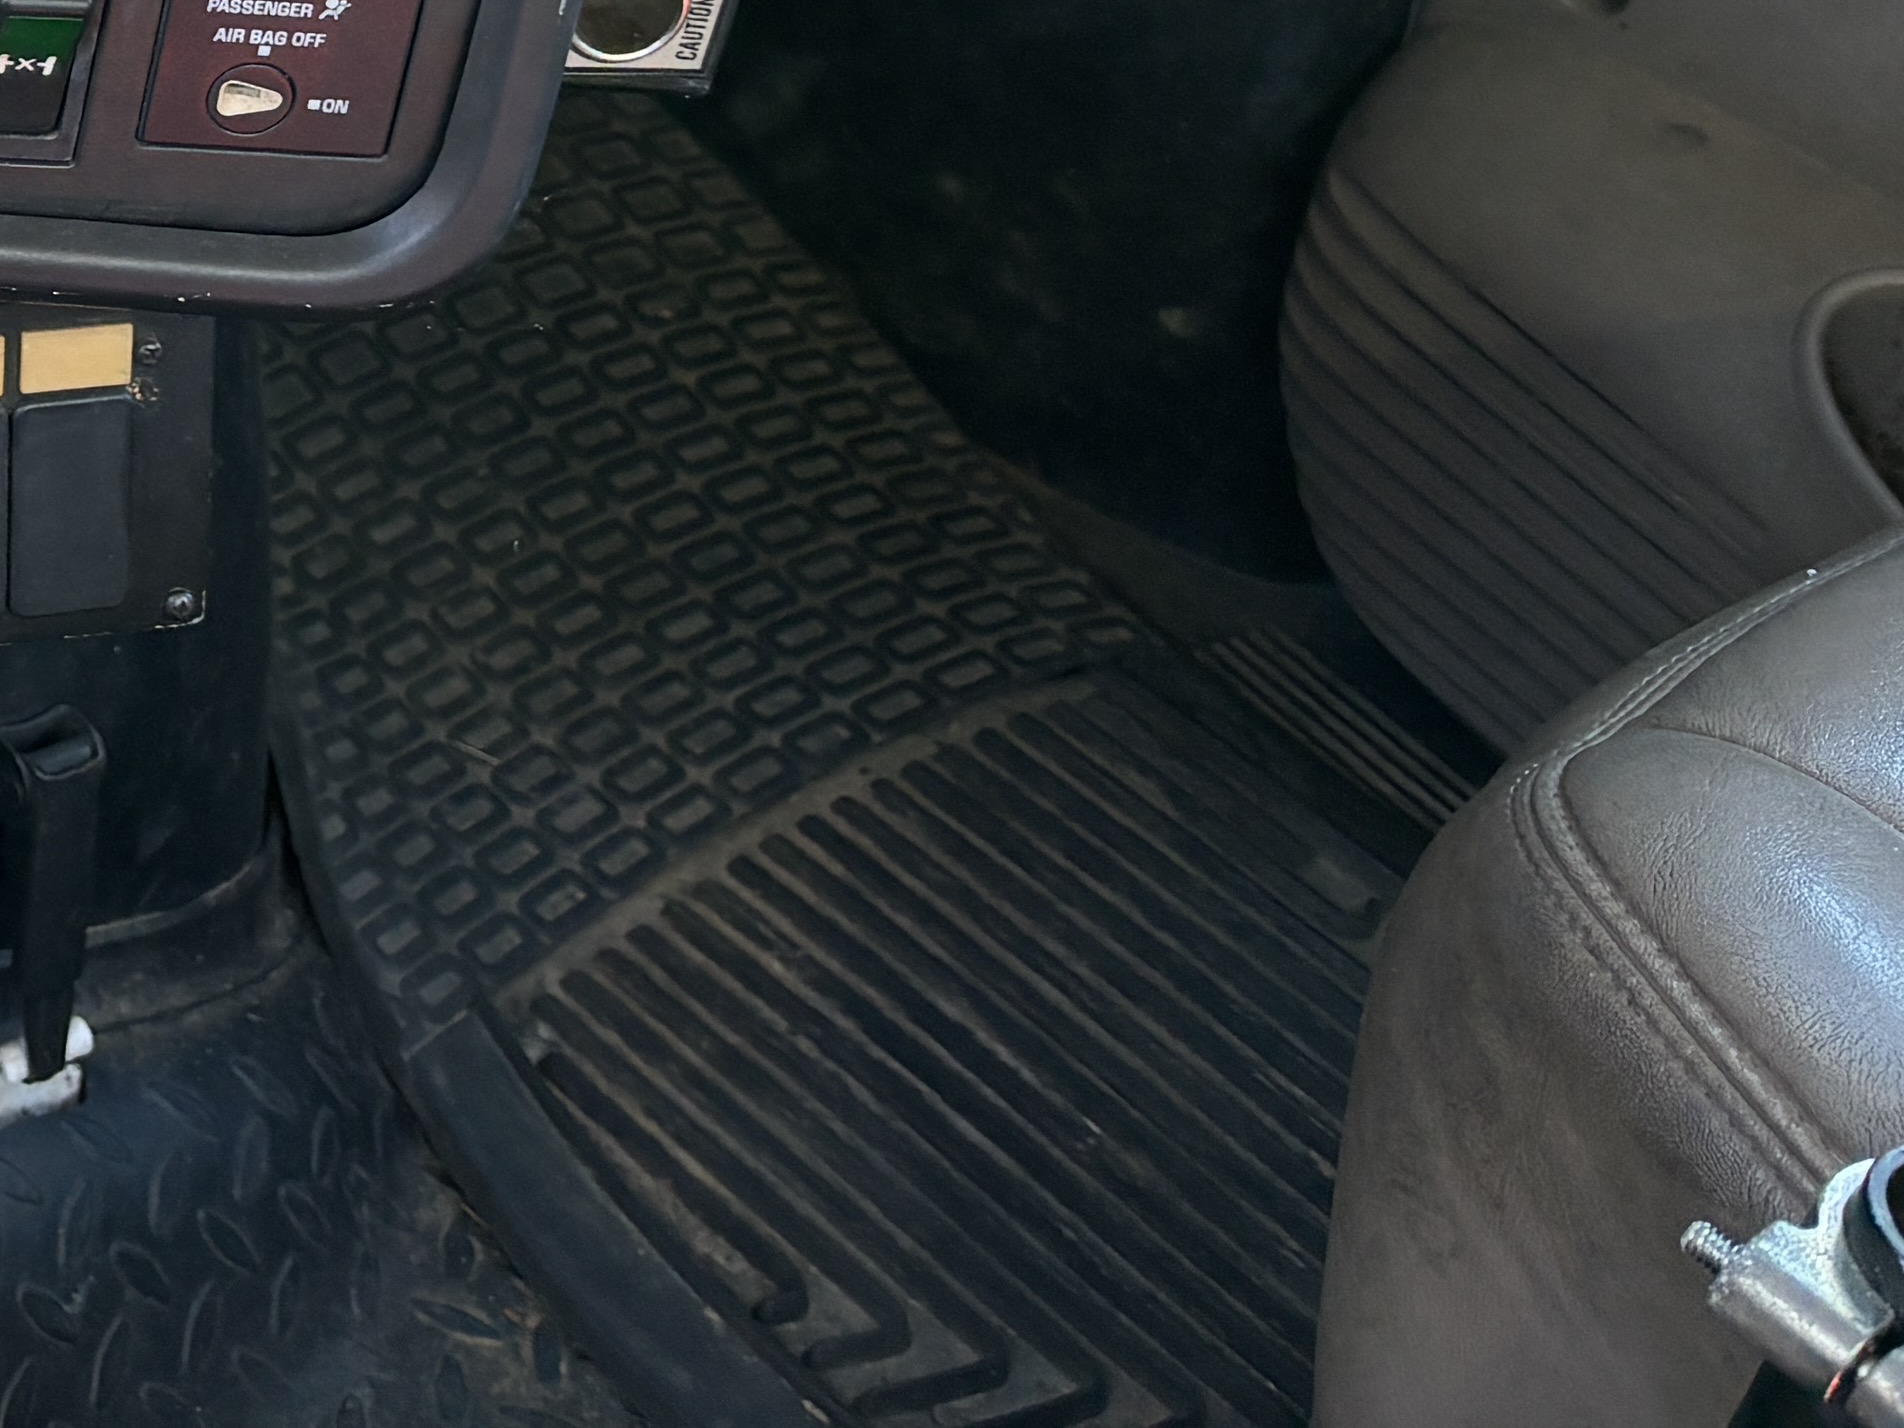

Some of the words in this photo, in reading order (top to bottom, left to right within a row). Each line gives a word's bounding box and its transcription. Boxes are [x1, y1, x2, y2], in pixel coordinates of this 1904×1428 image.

[212, 27, 246, 43] AIR
[249, 29, 288, 46] BAG
[291, 32, 328, 48] OFF
[321, 98, 350, 114] ON
